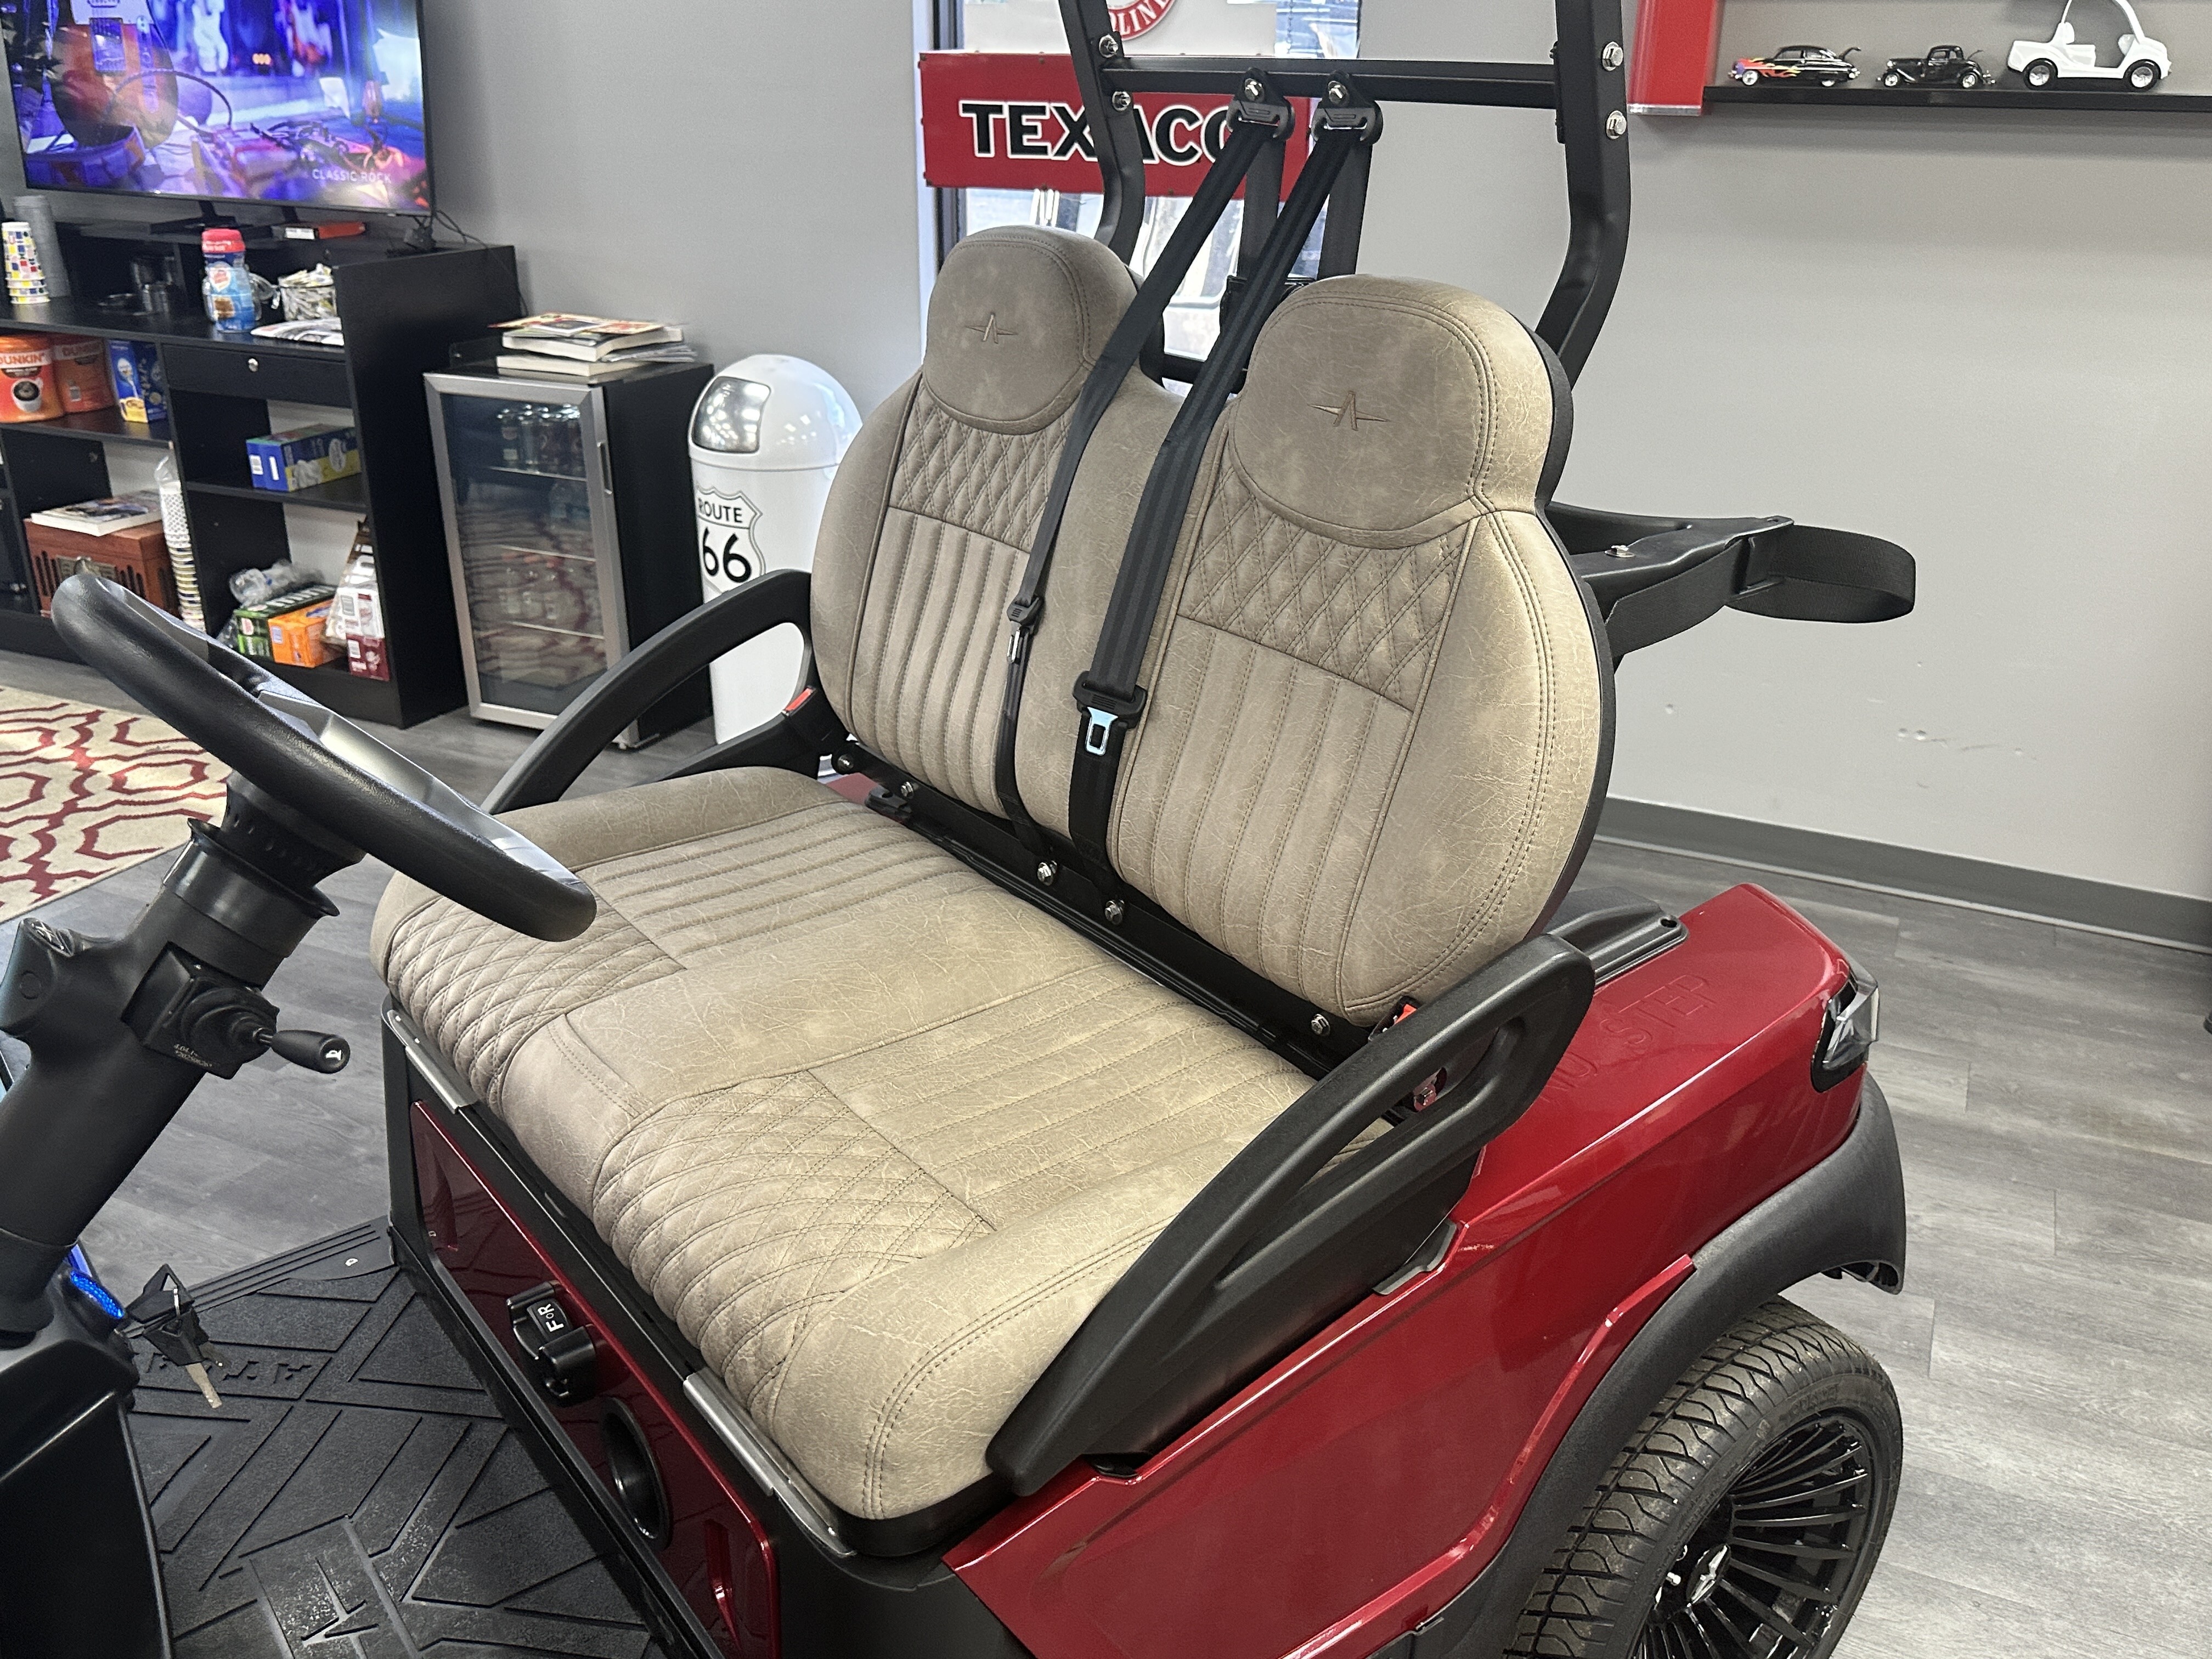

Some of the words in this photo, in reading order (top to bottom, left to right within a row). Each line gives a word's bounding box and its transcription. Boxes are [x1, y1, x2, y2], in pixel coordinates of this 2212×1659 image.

[312, 168, 357, 182] CLASSIC
[360, 171, 392, 184] ROCK
[698, 498, 742, 523] ROUTE
[703, 527, 752, 583] 66
[1599, 974, 1717, 1054] STEP
